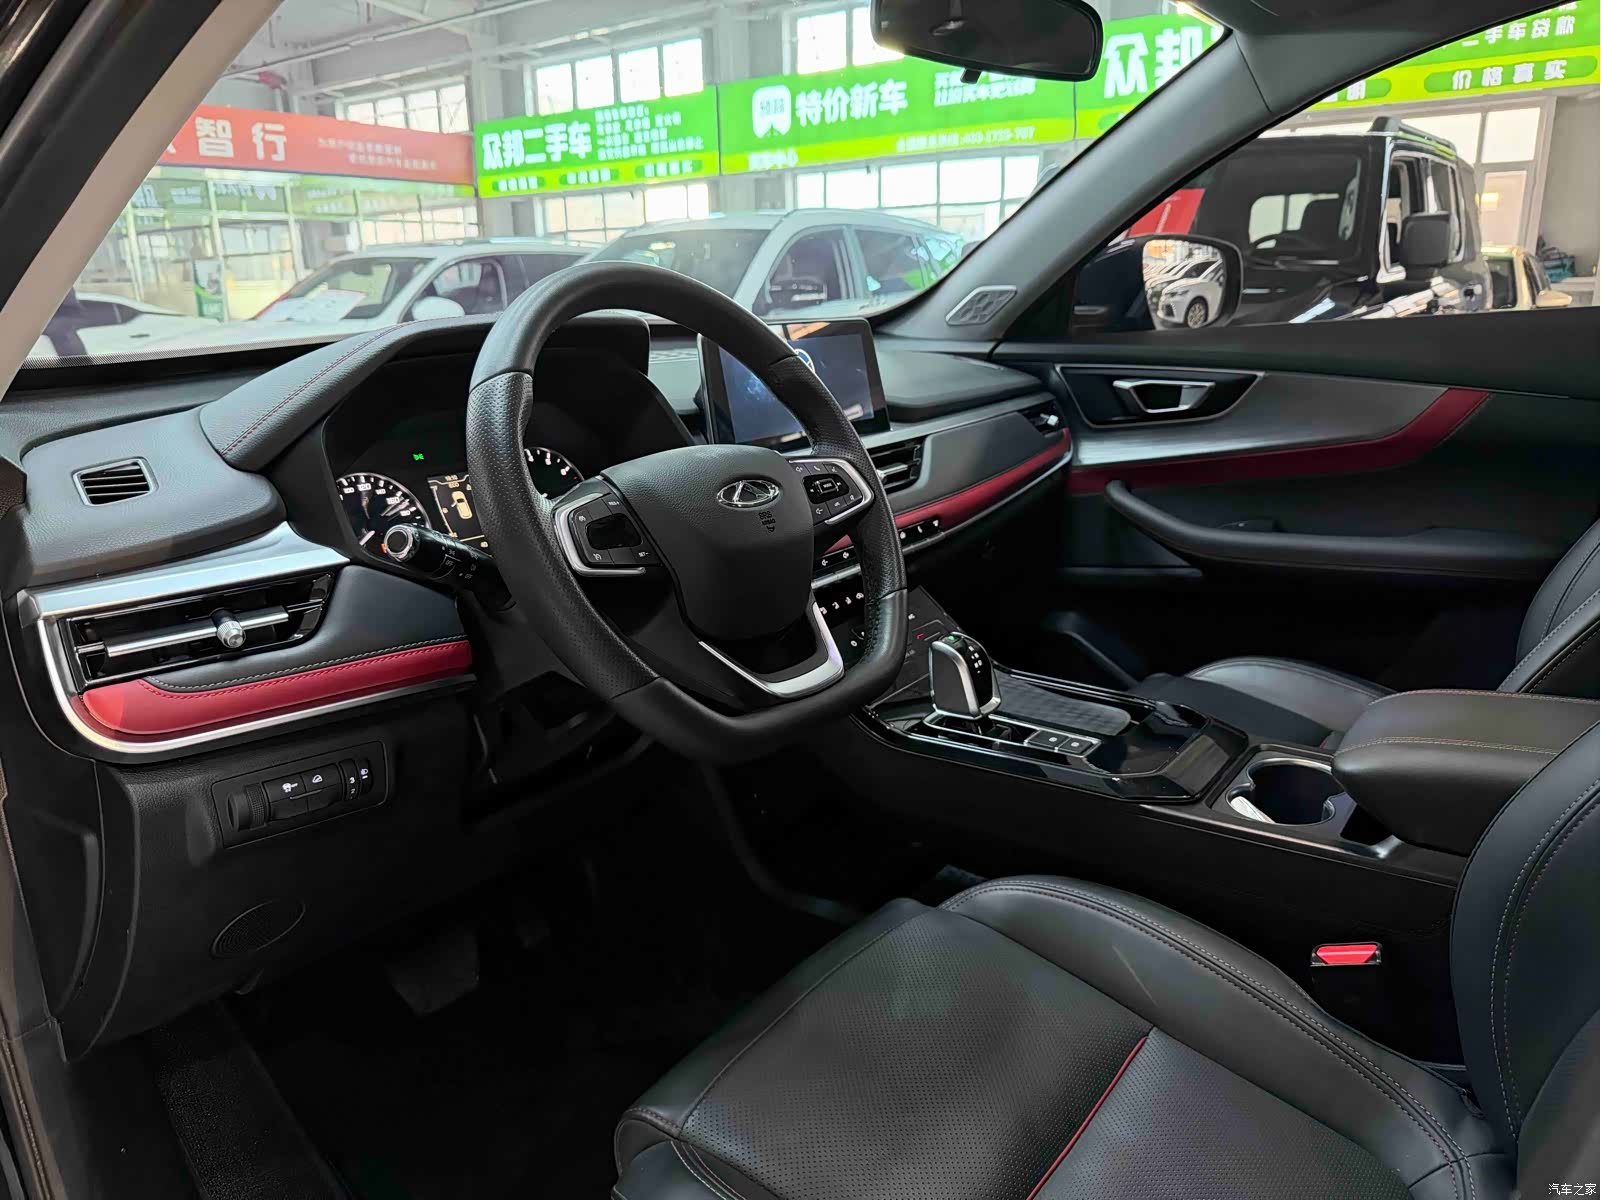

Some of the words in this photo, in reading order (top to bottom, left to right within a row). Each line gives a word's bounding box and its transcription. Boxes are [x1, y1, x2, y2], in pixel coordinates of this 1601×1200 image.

[1104, 26, 1225, 99] 众邦
[1452, 59, 1567, 91] 价格真实
[796, 79, 908, 127] 特价新车
[166, 116, 288, 162] 智行
[482, 121, 593, 170] 众邦二手车
